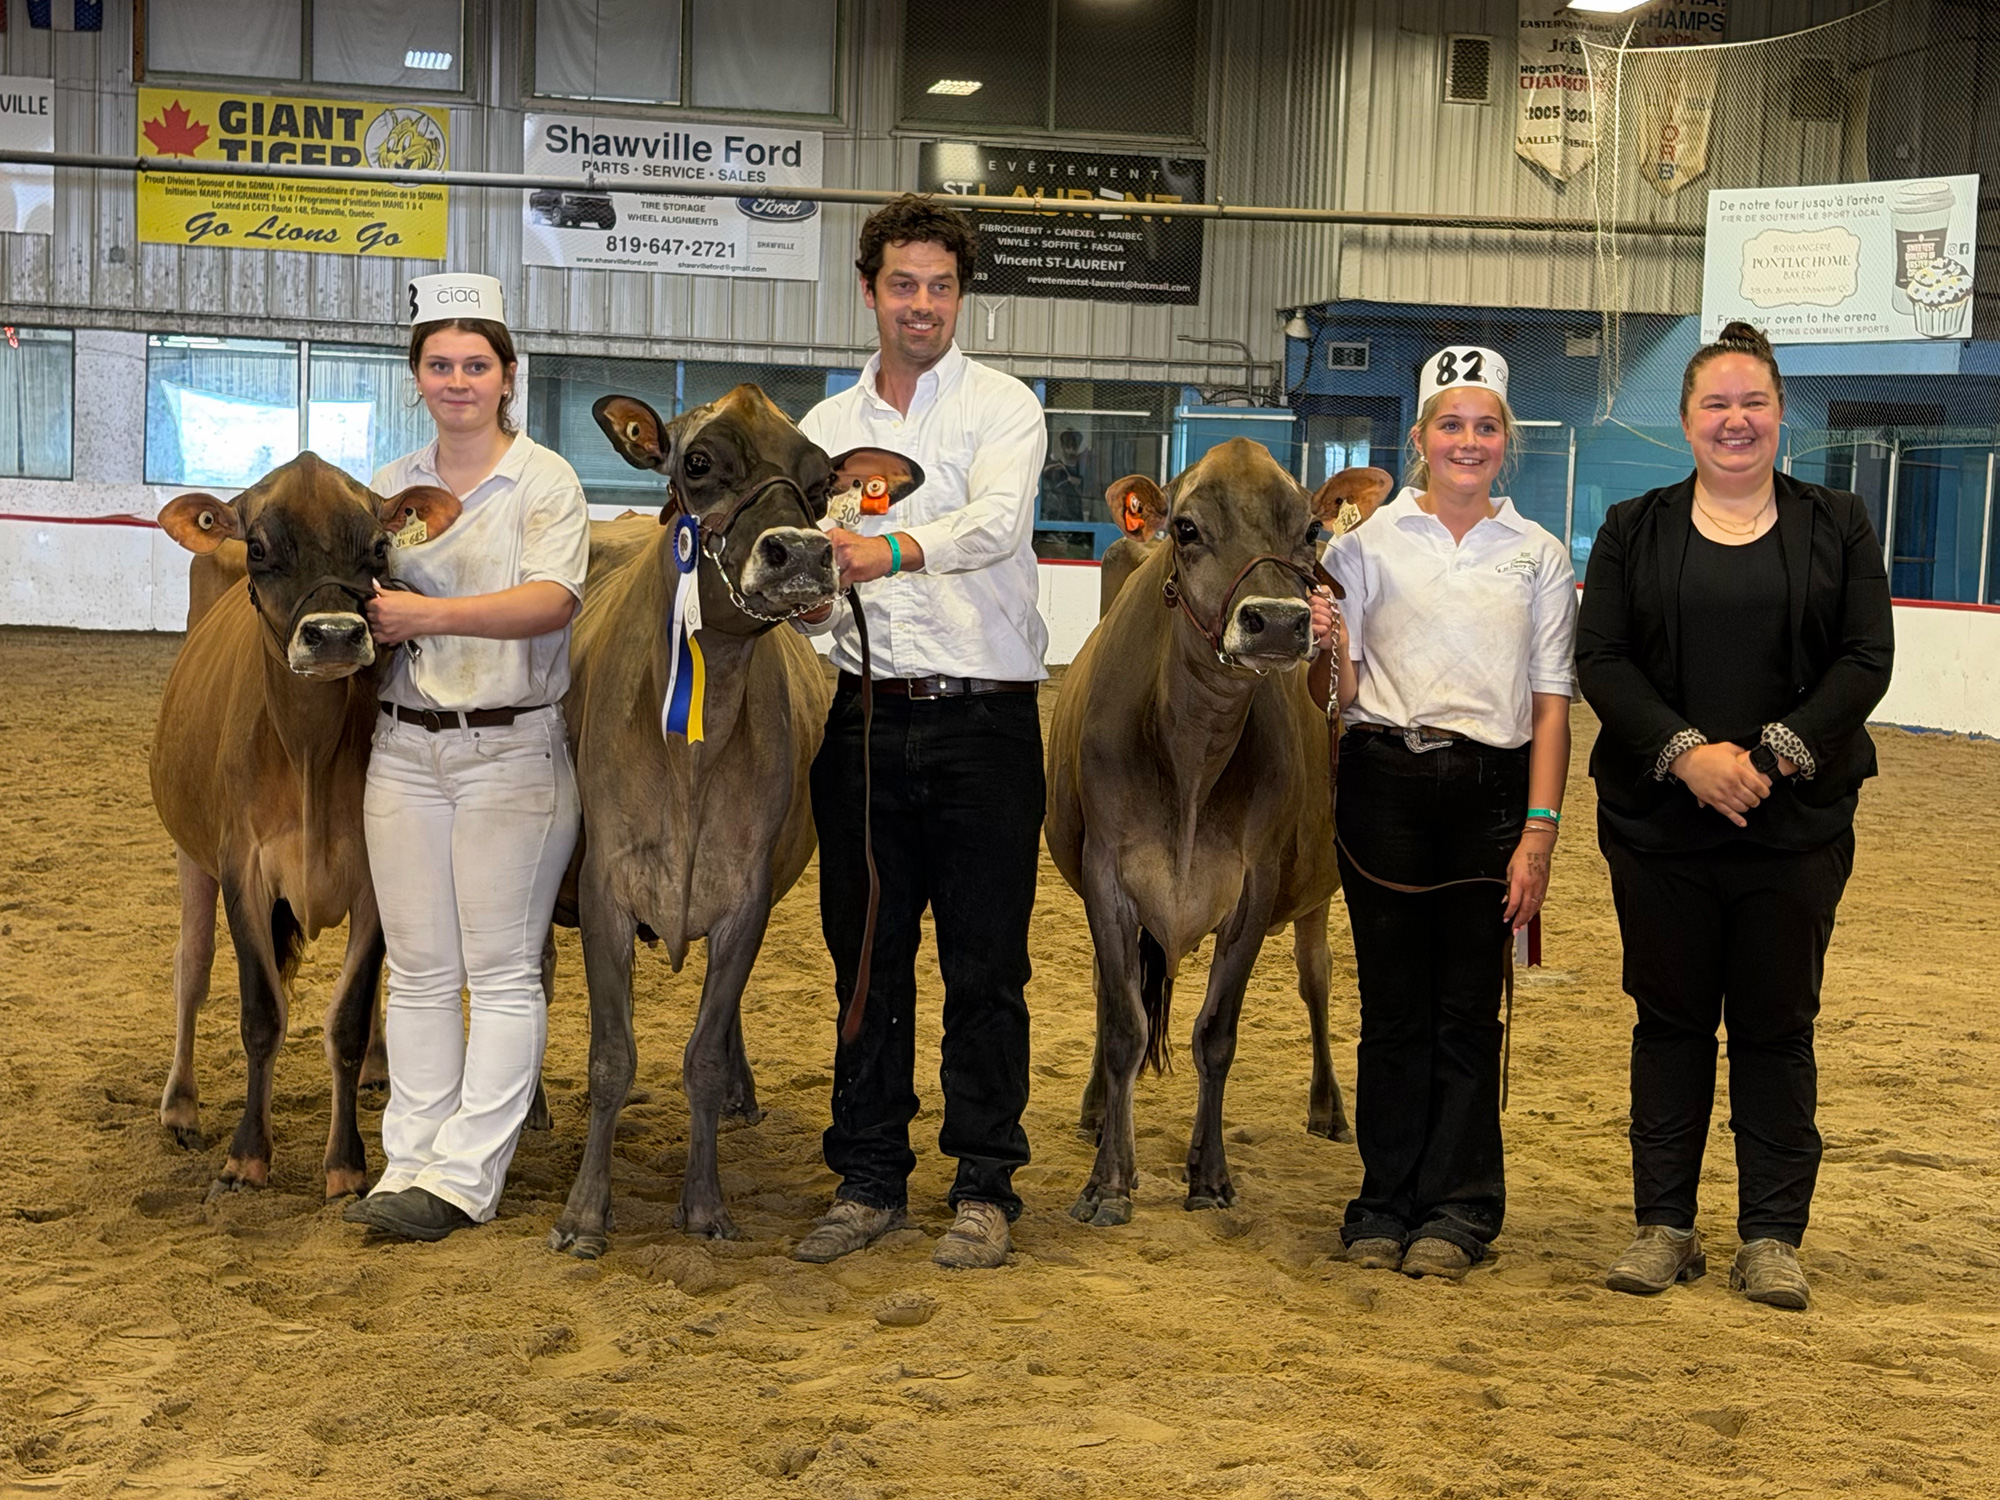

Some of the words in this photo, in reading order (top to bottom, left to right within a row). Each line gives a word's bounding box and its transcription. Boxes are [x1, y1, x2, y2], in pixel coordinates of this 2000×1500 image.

[219, 100, 364, 141] GIANT
[545, 124, 713, 163] Shawville
[724, 135, 802, 168] Ford
[582, 160, 630, 175] PARTS
[642, 165, 706, 180] SERVICE
[718, 169, 766, 183] SALES
[145, 175, 166, 184] Proud
[167, 176, 196, 186] Division
[197, 178, 226, 188] Sponsor
[226, 180, 235, 188] of
[236, 180, 247, 189] the
[281, 183, 295, 192] Fier
[371, 189, 399, 198] Division
[399, 191, 409, 199] de
[165, 186, 198, 197] Initiation
[223, 190, 271, 201] PROGRAMME
[279, 194, 287, 202] to
[288, 194, 293, 203] 4
[299, 195, 341, 205] Programme
[211, 201, 241, 211] Located
[242, 202, 250, 212] at
[271, 203, 293, 213] Route
[641, 201, 661, 211] TIRE
[663, 202, 706, 213] STORAGE
[1719, 200, 1735, 211] De
[1739, 200, 1770, 211] notre
[1775, 198, 1799, 210] four
[627, 213, 660, 223] WHEEL
[661, 215, 719, 226] ALIGNMENTS
[1721, 213, 1742, 223] FIER
[1745, 213, 1757, 222] DE
[1760, 212, 1805, 222] SOUTENIR
[1808, 211, 1819, 220] LE
[1821, 210, 1849, 220] SPORT
[1853, 209, 1881, 218] LOCAL
[185, 211, 233, 243] Go
[244, 214, 341, 243] Lions
[356, 221, 403, 253] Go
[979, 223, 1044, 236] FIBROCIMENT
[1054, 228, 1097, 239] CANEXEL
[1107, 231, 1143, 241] MAIBEC
[757, 241, 795, 251] SHAWVILLE
[997, 238, 1030, 248] VINYLE
[1042, 240, 1081, 250] SOFFITE
[1092, 243, 1124, 252] FASCIA
[993, 254, 1043, 268] Vincent
[1045, 257, 1127, 272] ST-LAURENT
[1752, 256, 1810, 269] PONTIAC
[1812, 254, 1851, 267] HOME
[1783, 269, 1819, 280] BAKERY
[1027, 276, 1191, 292] revetementst-laurent@hotmail.com
[1752, 316, 1771, 325] our
[1775, 314, 1803, 324] oven
[1806, 312, 1817, 323] to
[1821, 312, 1840, 323] the
[1844, 312, 1877, 322] arena
[1803, 326, 1854, 336] COMMUNITY
[1856, 324, 1890, 334] SPORTS
[1436, 350, 1488, 386] 82
